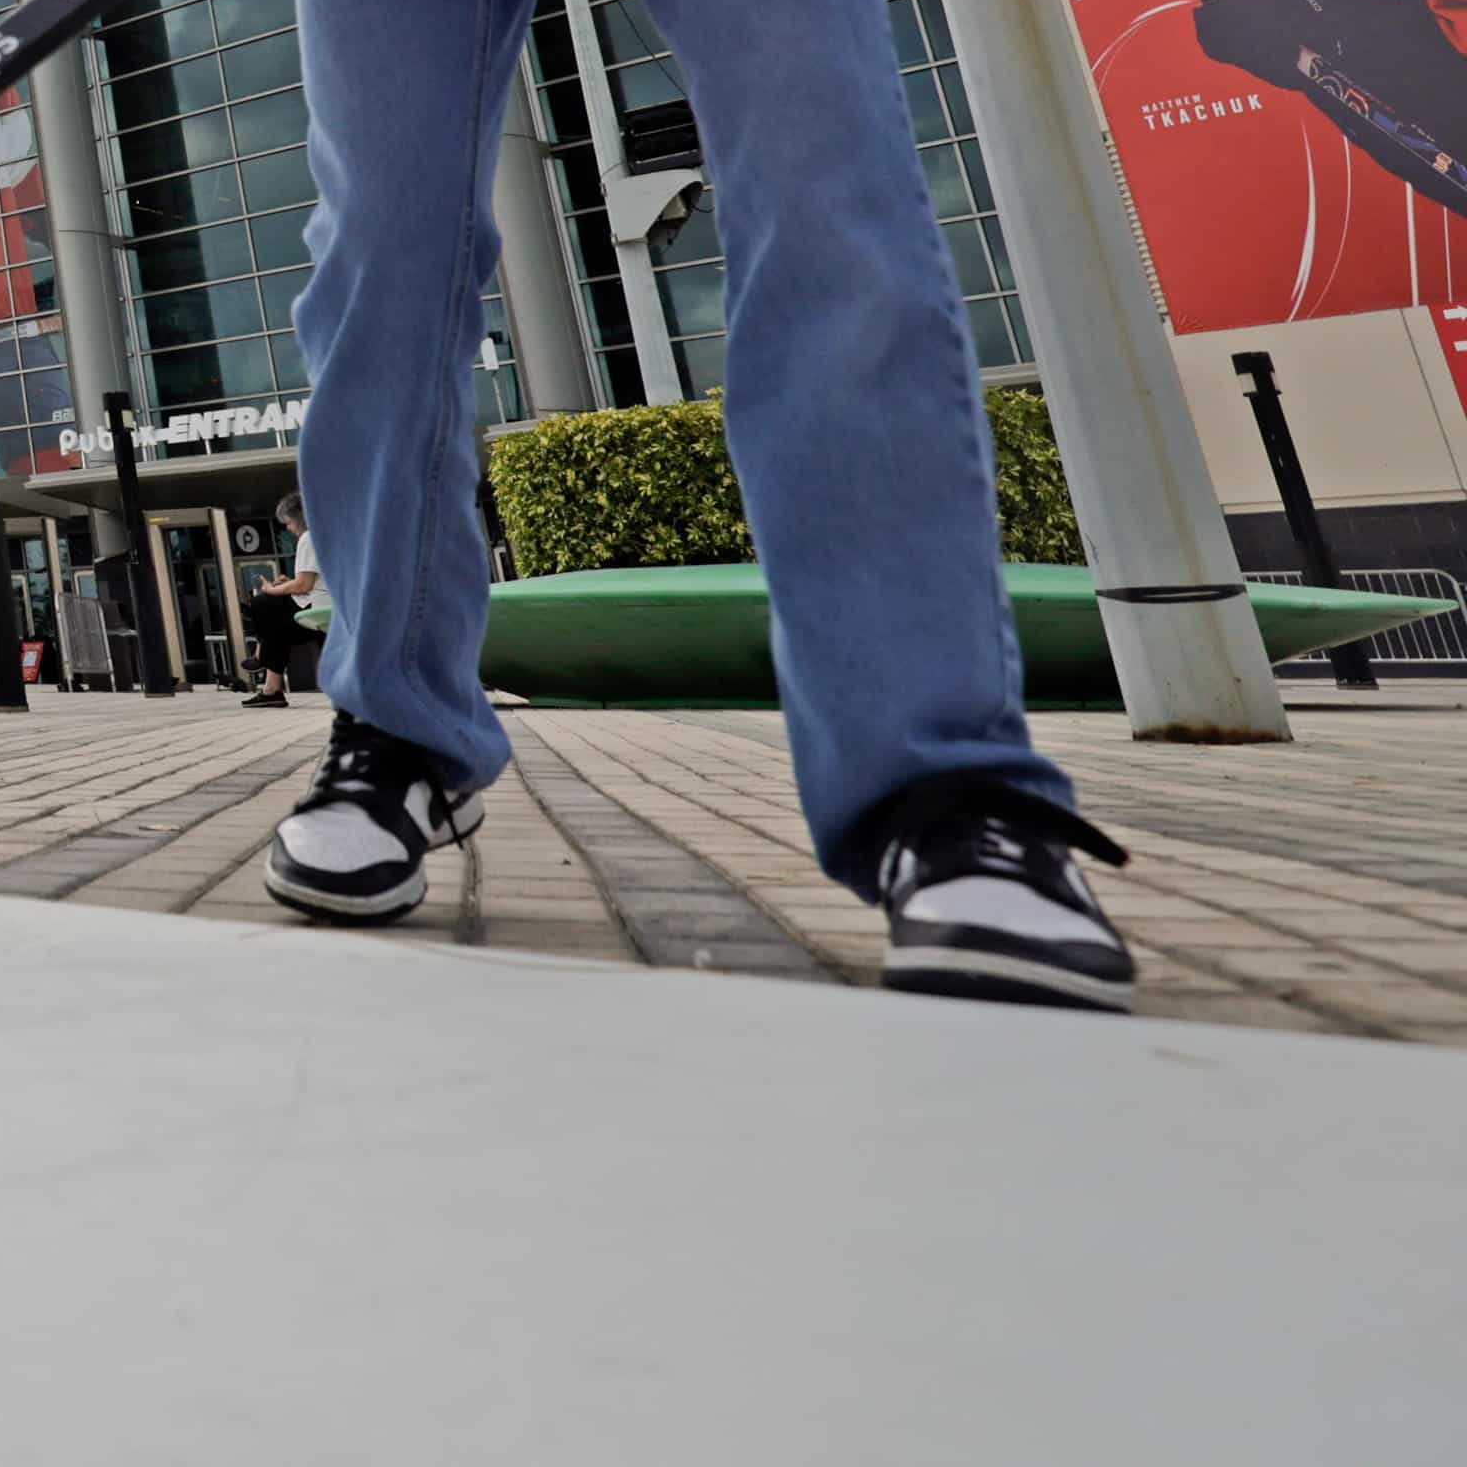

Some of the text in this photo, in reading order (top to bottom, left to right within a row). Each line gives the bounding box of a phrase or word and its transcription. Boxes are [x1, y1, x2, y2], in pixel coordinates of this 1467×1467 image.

[1141, 92, 1201, 114] MATTHEW
[1144, 93, 1263, 131] TKACHUK
[58, 419, 158, 457] Pubix
